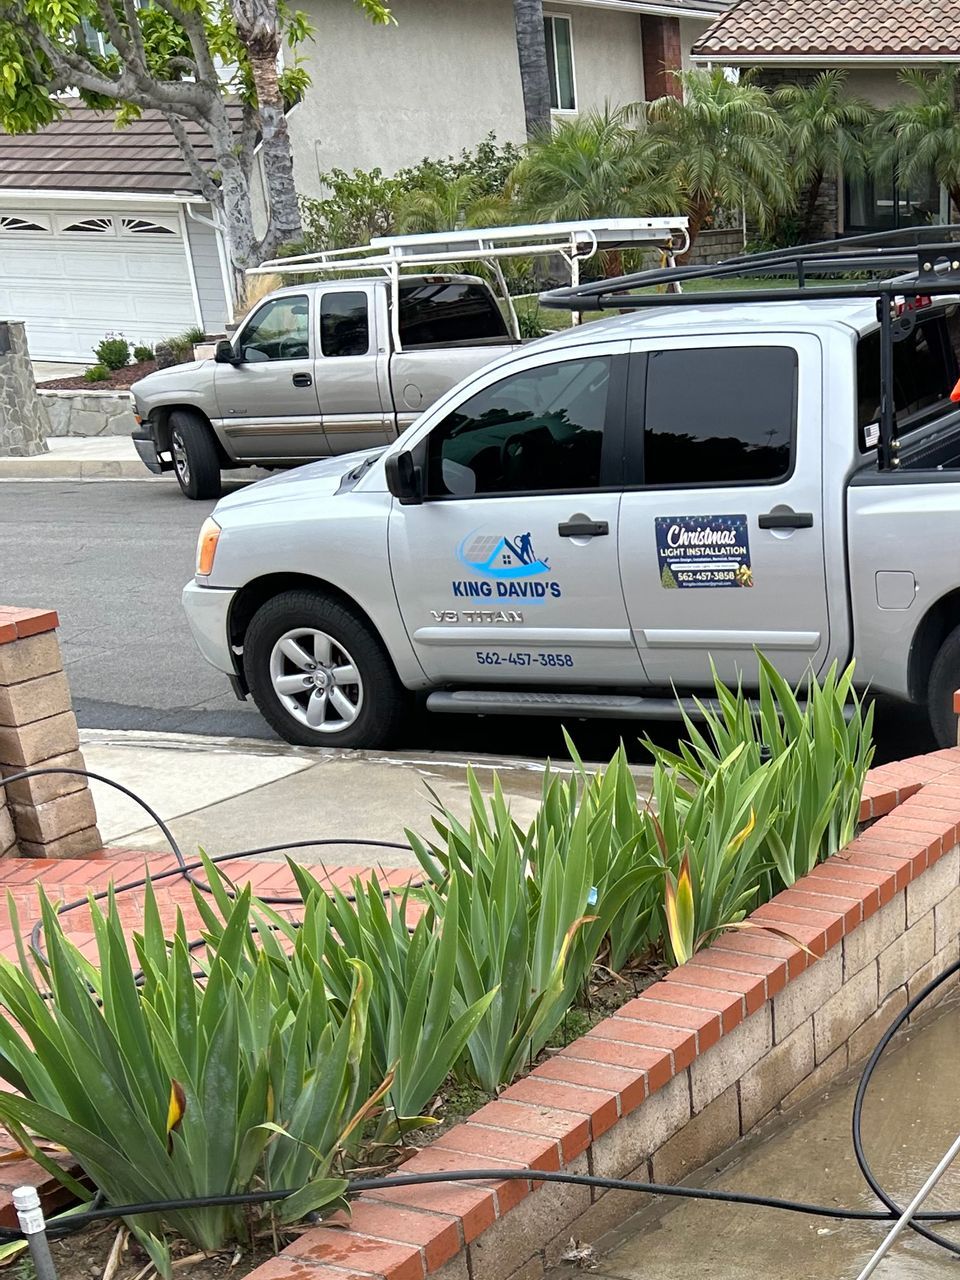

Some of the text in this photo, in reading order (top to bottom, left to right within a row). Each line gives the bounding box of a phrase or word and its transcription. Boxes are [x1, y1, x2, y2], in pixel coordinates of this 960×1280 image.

[667, 525, 736, 547] Christmas
[660, 546, 747, 556] LIGHT INSTALLATION
[678, 571, 735, 581] 562-457-3858
[452, 581, 561, 598] KING DAVID'S
[430, 610, 523, 623] V8 TITAN
[476, 651, 574, 667] 562-457-3858
